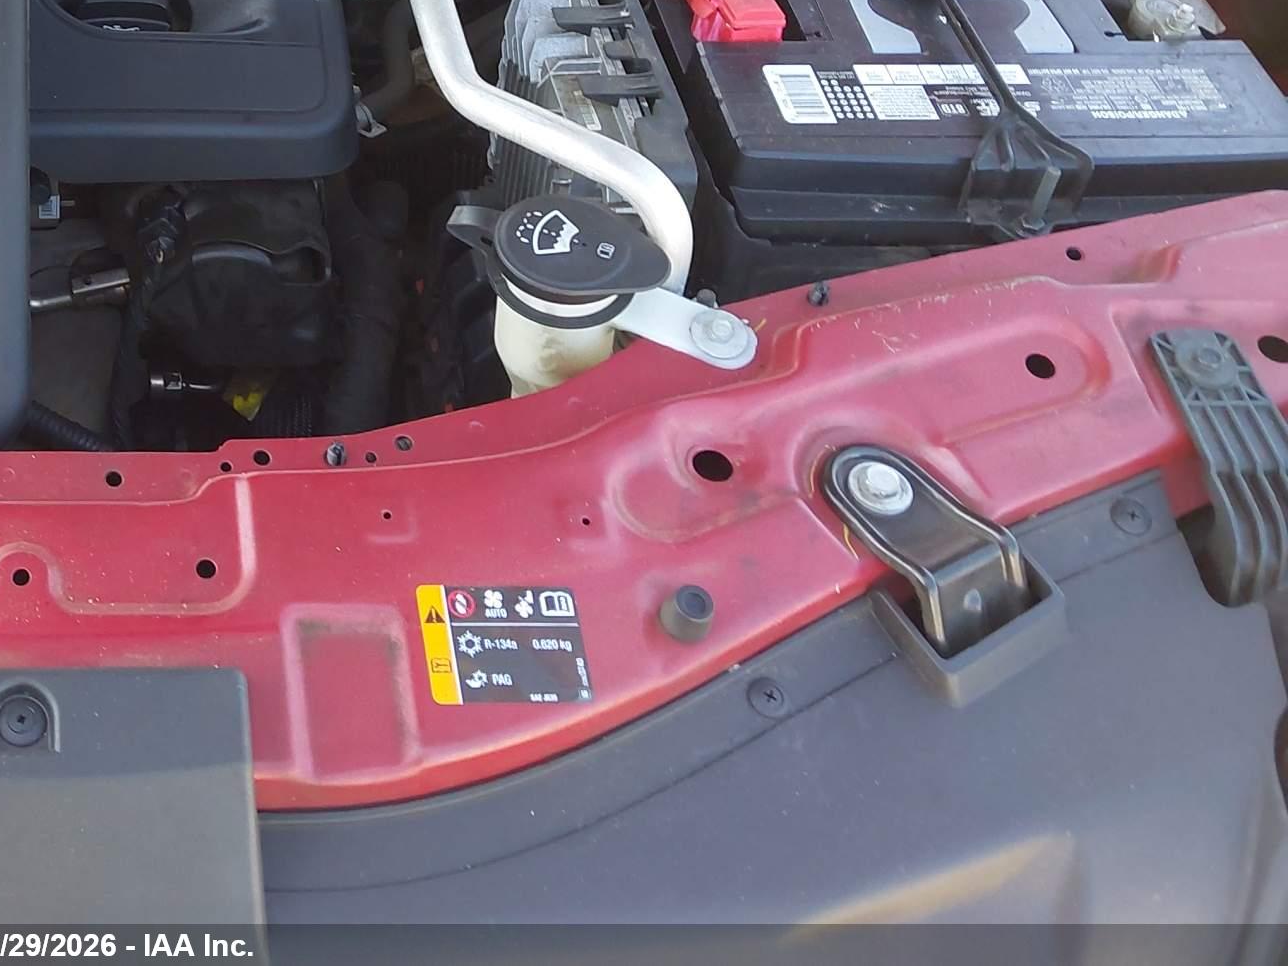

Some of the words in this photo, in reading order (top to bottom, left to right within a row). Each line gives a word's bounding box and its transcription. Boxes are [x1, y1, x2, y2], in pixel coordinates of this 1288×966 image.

[485, 608, 507, 618] AUTO
[484, 638, 518, 650] R-134a
[559, 638, 573, 652] kg
[492, 673, 513, 686] PAG
